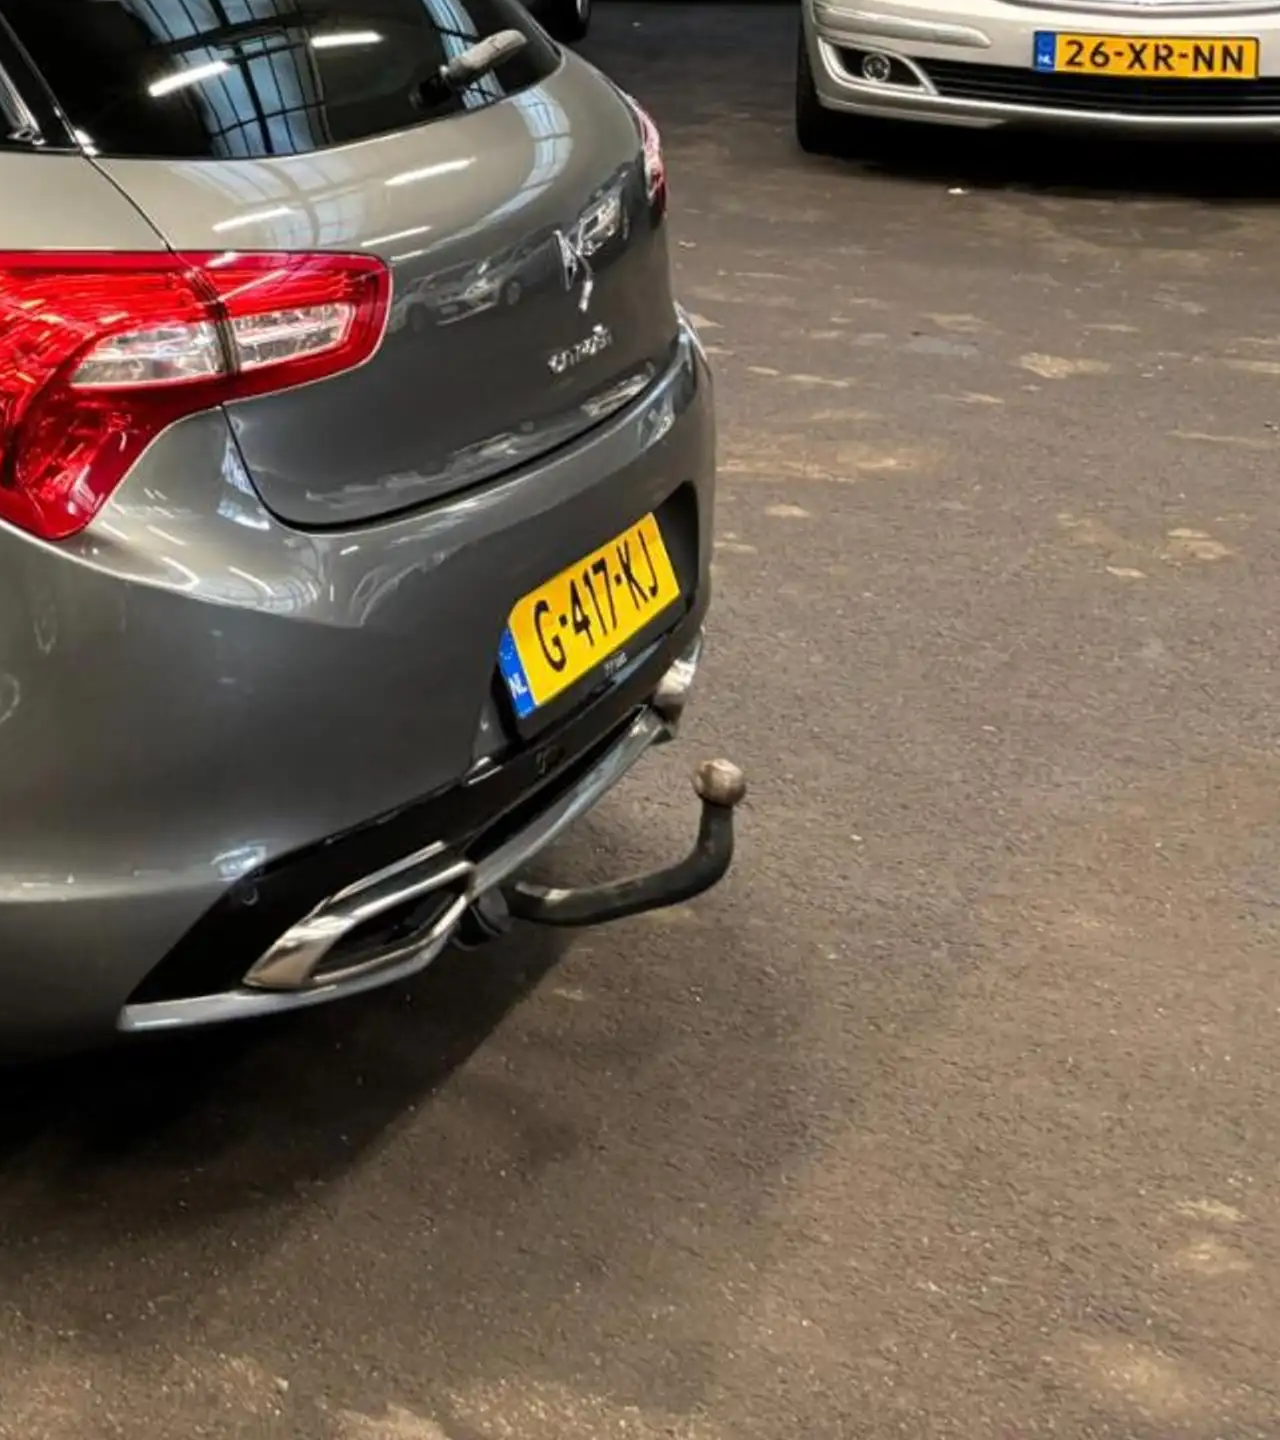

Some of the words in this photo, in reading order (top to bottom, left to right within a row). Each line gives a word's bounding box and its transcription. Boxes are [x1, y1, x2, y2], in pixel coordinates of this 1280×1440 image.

[1064, 39, 1244, 72] 26-XR-NN
[508, 672, 528, 700] NL
[534, 528, 659, 673] G-417-KJ
